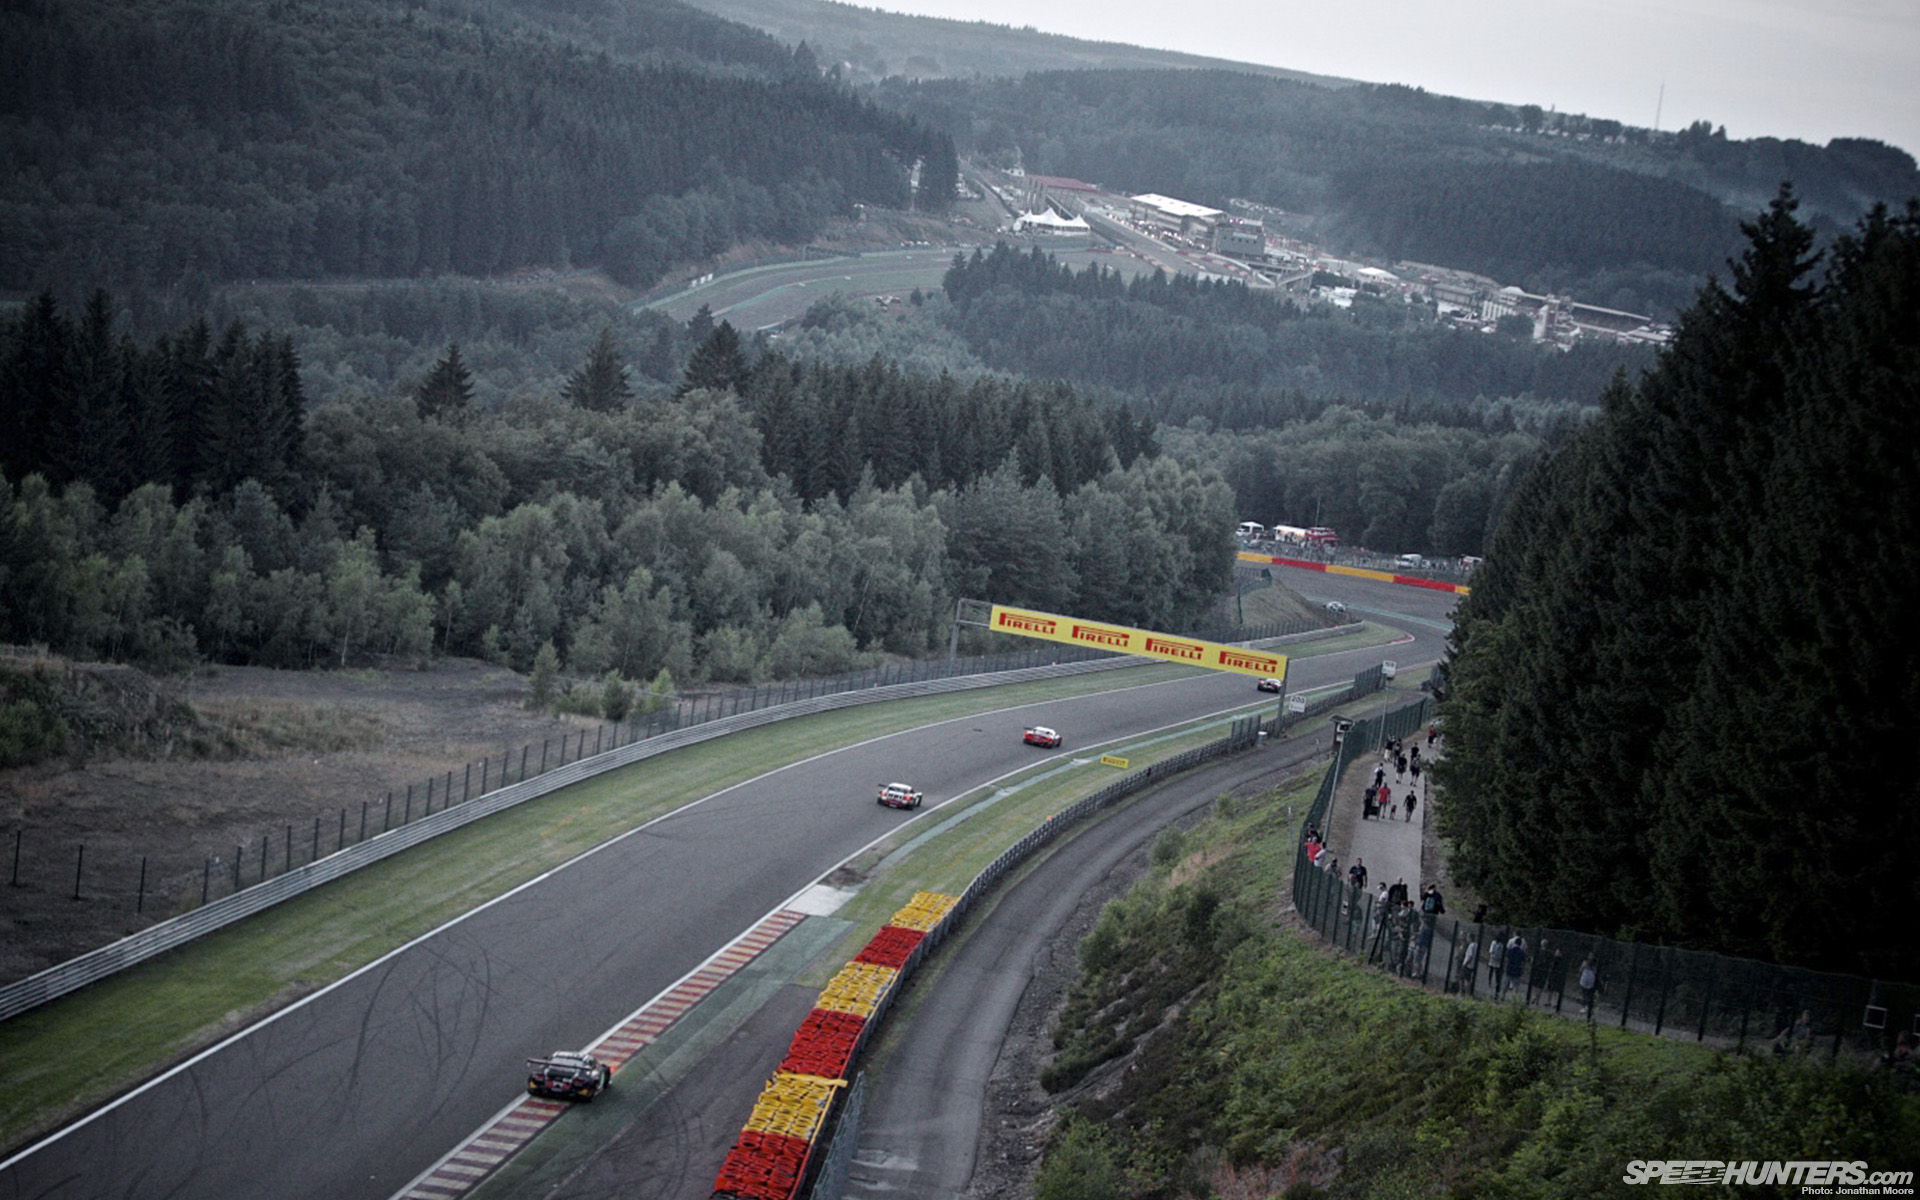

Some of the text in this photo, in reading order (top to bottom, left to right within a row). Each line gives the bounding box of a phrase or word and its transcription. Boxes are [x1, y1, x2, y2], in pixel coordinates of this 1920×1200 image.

[999, 612, 1278, 673] PIRELLI PIRELLI PIRELLI PIRELLI
